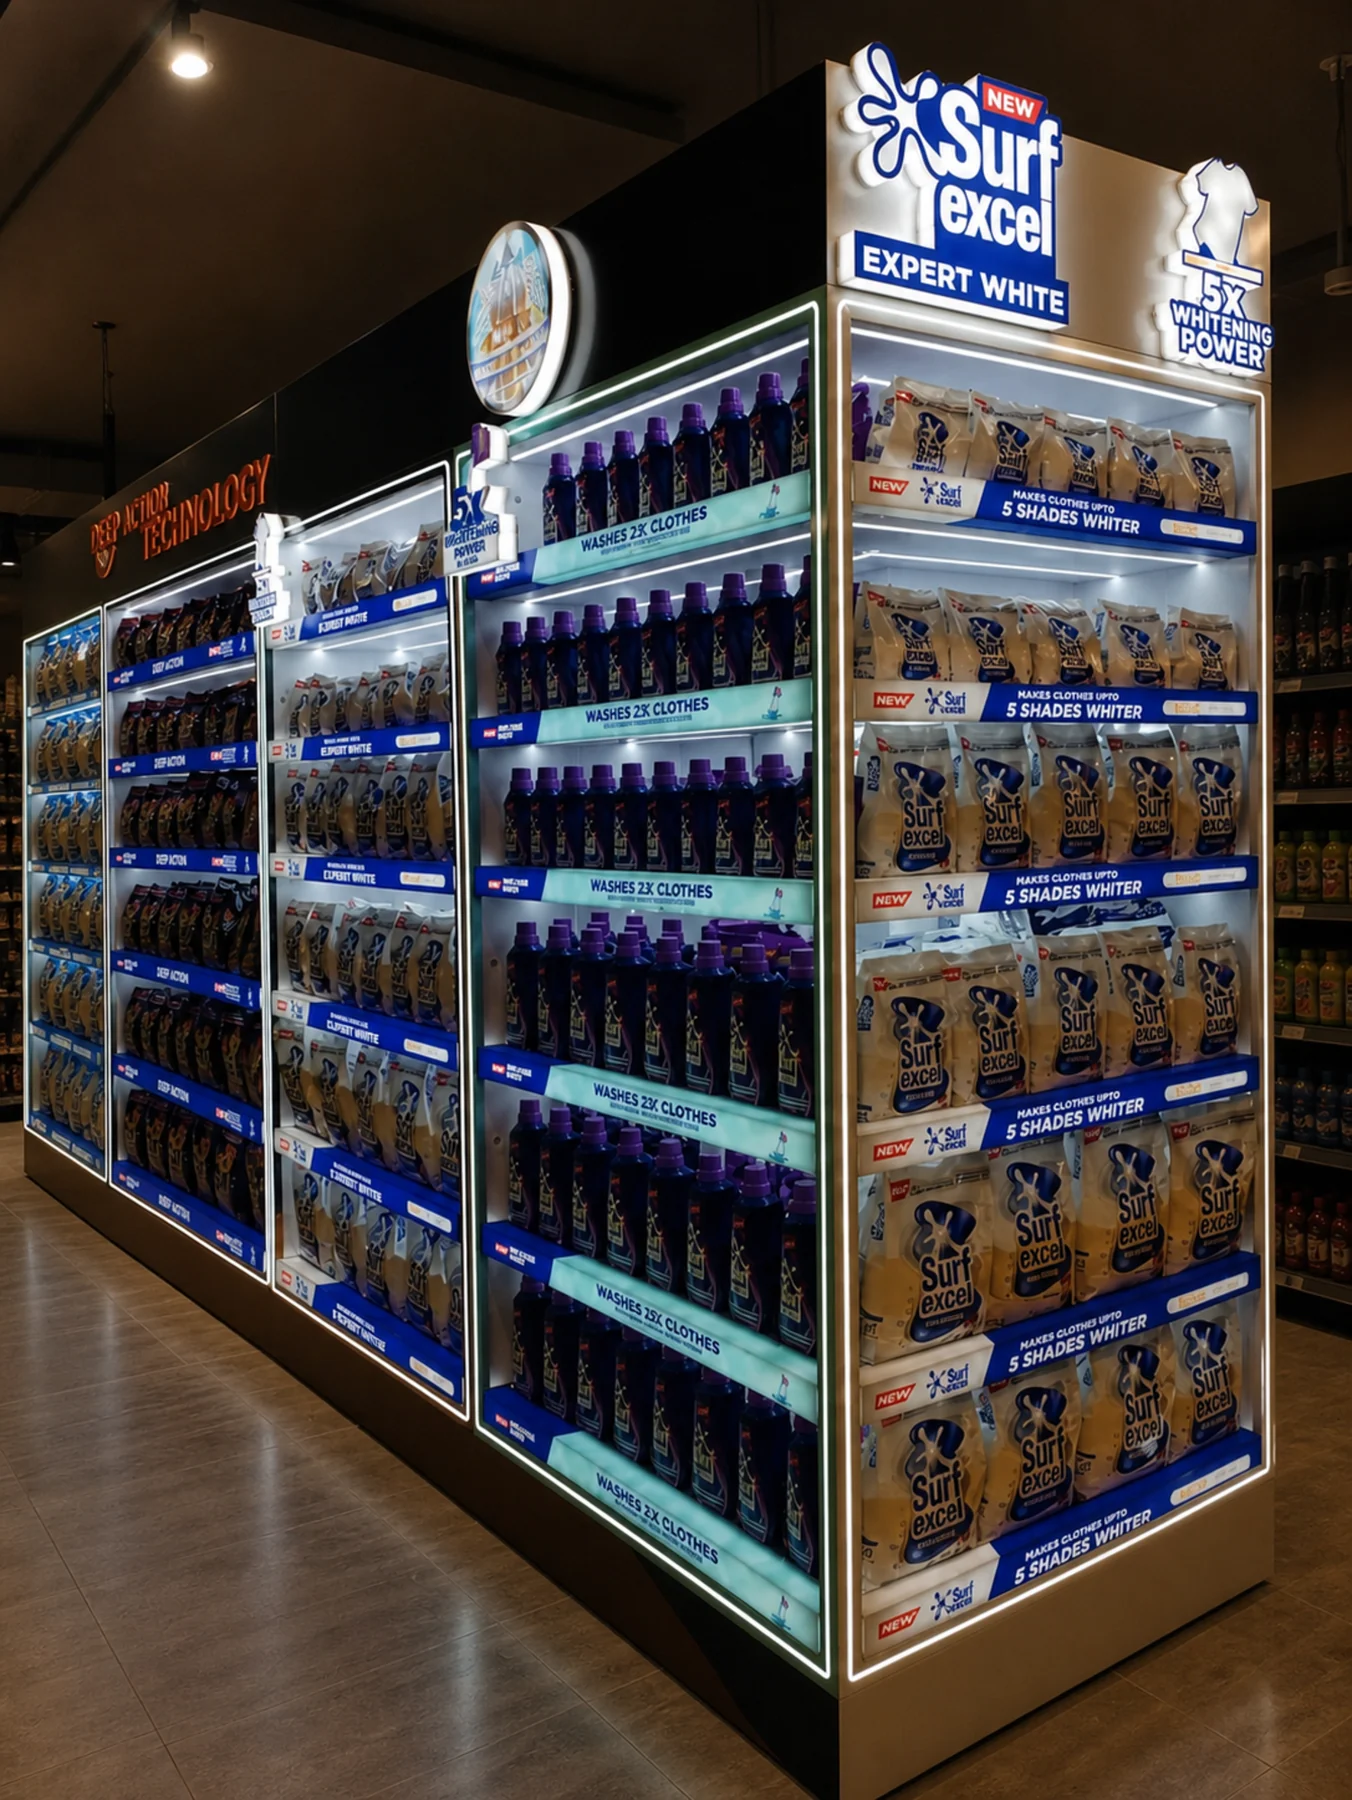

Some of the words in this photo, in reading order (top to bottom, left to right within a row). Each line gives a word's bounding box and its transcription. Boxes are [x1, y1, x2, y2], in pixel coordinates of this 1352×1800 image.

[987, 88, 1035, 118] NEW
[939, 89, 1059, 201] Surf
[939, 184, 1052, 257] excel
[862, 245, 973, 293] EXPERT
[980, 271, 1064, 315] WHITE
[1201, 271, 1246, 318] 5X
[1172, 301, 1273, 346] WHITENING
[1180, 332, 1264, 369] POWER
[872, 479, 906, 492] NEW
[940, 482, 962, 497] Surf
[141, 454, 271, 561] TECHNOLOGY
[1013, 490, 1045, 502] MAKES
[1091, 502, 1115, 513] UPTO
[91, 511, 120, 554] DEEP
[581, 528, 628, 552] WASHES
[650, 505, 707, 534] CLOTHES
[1002, 501, 1012, 517] 5
[1015, 503, 1078, 526] SHADES
[1083, 513, 1140, 535] WHITER
[586, 707, 631, 723] WASHES
[653, 697, 709, 715] CLOTHES
[876, 695, 908, 707] NEW
[944, 691, 966, 706] Surf
[1018, 691, 1051, 700] MAKES
[1095, 692, 1119, 702] UPTO
[1007, 703, 1017, 718] 5
[1021, 703, 1086, 719] SHADES
[1090, 705, 1142, 720] WHITER
[903, 799, 944, 828] Surf
[986, 800, 1023, 825] Surf
[1138, 793, 1172, 819] Surf
[1201, 793, 1233, 817] Surf
[903, 828, 944, 848] excel
[986, 824, 1023, 841] excel
[1065, 818, 1099, 836] excel
[1138, 818, 1171, 835] excel
[1201, 818, 1234, 834] excel
[590, 878, 635, 895] WASHES
[657, 882, 713, 899] CLOTHES
[943, 883, 964, 899] Surf
[1016, 874, 1050, 884] MAKES
[1094, 870, 1118, 880] UPTO
[875, 894, 908, 905] NEW
[1005, 891, 1015, 905] 5
[1018, 886, 1081, 903] SHADES
[1085, 880, 1142, 898] WHITER
[1134, 997, 1166, 1026] Surf
[1204, 991, 1235, 1017] Surf
[1061, 1006, 1096, 1033] Surf
[1135, 1023, 1167, 1043] excel
[1206, 1013, 1234, 1033] excel
[901, 1038, 943, 1068] Surf
[980, 1024, 1018, 1054] Surf
[1062, 1030, 1097, 1051] excel
[981, 1050, 1019, 1072] excel
[901, 1065, 943, 1089] excel
[593, 1083, 639, 1107] WASHES
[661, 1102, 717, 1127] CLOTHES
[1006, 1125, 1017, 1140] 5
[1020, 1111, 1083, 1138] SHADES
[1086, 1098, 1144, 1125] WHITER
[1017, 1103, 1052, 1120] MAKES
[1096, 1091, 1121, 1104] UPTO
[944, 1124, 967, 1142] Surf
[876, 1141, 910, 1159] NEW
[1117, 1181, 1155, 1223] Surf
[1200, 1177, 1240, 1215] Surf
[1016, 1202, 1062, 1247] Surf
[1119, 1217, 1158, 1245] excel
[1200, 1210, 1239, 1235] excel
[920, 1246, 971, 1292] Surf
[1019, 1240, 1064, 1270] excel
[920, 1280, 973, 1315] excel
[596, 1283, 642, 1316] WASHES
[664, 1315, 720, 1356] CLOTHES
[1020, 1333, 1055, 1351] MAKES
[1099, 1310, 1122, 1324] UPTO
[1009, 1356, 1019, 1372] 5
[1022, 1336, 1085, 1370] SHADES
[1090, 1314, 1147, 1343] WHITER
[947, 1365, 969, 1385] Surf
[1192, 1360, 1230, 1398] Surf
[878, 1386, 911, 1407] NEW
[1125, 1384, 1160, 1427] Surf
[1196, 1388, 1231, 1420] excel
[1125, 1417, 1162, 1446] excel
[1022, 1432, 1064, 1473] Surf
[912, 1466, 962, 1511] Surf
[1021, 1460, 1066, 1495] excel
[596, 1472, 642, 1514] WASHES
[663, 1510, 718, 1565] CLOTHES
[913, 1499, 965, 1536] excel
[1015, 1568, 1025, 1585] 5
[1028, 1543, 1091, 1578] SHADES
[1095, 1509, 1152, 1546] WHITER
[1025, 1541, 1060, 1562] MAKES
[1104, 1509, 1127, 1523] UPTO
[952, 1581, 973, 1601] Surf
[881, 1612, 917, 1634] NEW
